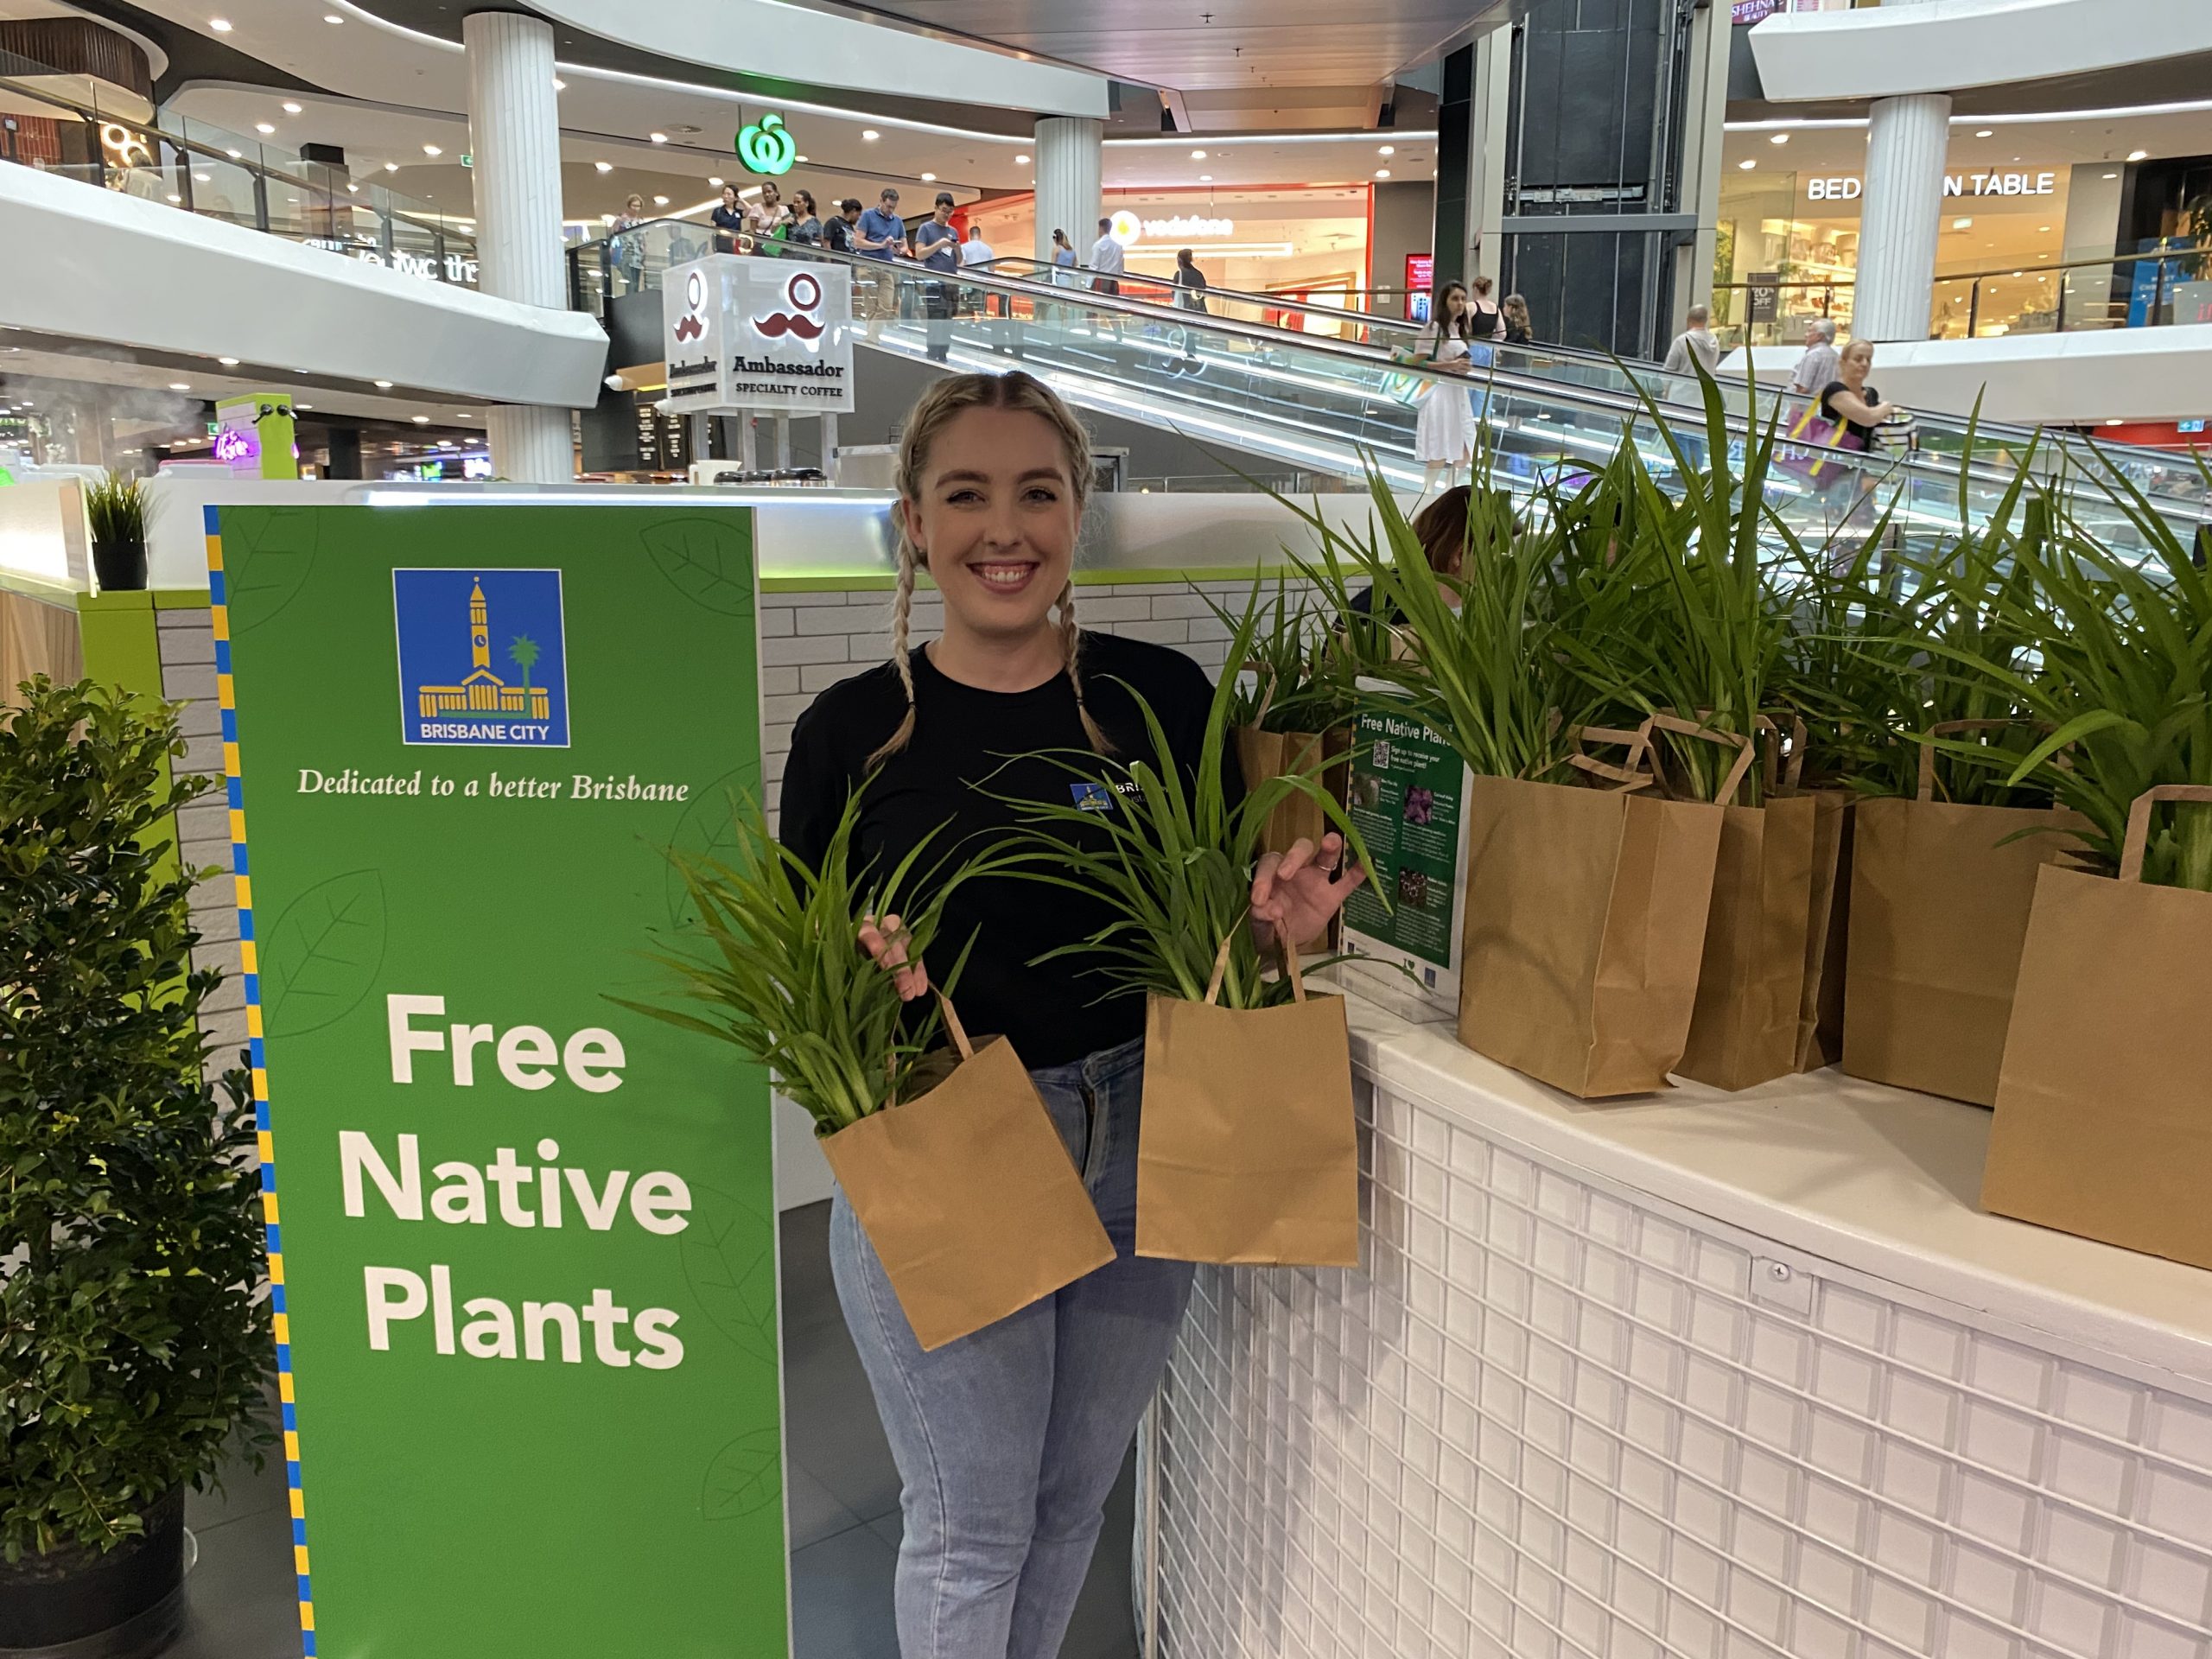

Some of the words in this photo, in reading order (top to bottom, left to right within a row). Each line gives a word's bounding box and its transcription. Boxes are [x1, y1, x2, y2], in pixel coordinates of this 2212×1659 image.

[1807, 177, 1861, 200] BED
[1943, 175, 1963, 197] N
[1970, 173, 2056, 196] TABLE
[1142, 214, 1234, 237] vodafone
[733, 355, 844, 378] Ambassador
[735, 382, 798, 396] SPECIALTY
[800, 385, 843, 397] COFFEE
[420, 723, 507, 740] BRISBANE
[510, 725, 550, 741] CITY
[1361, 713, 1382, 732] Free
[1385, 717, 1420, 739] Native
[296, 768, 422, 796] Dedicated
[431, 774, 454, 797] to
[464, 779, 480, 797] a
[488, 771, 562, 799] better
[569, 774, 689, 802] Brisbane
[386, 993, 626, 1093] Free
[338, 1129, 692, 1236] Native
[363, 1263, 684, 1370] Plants
